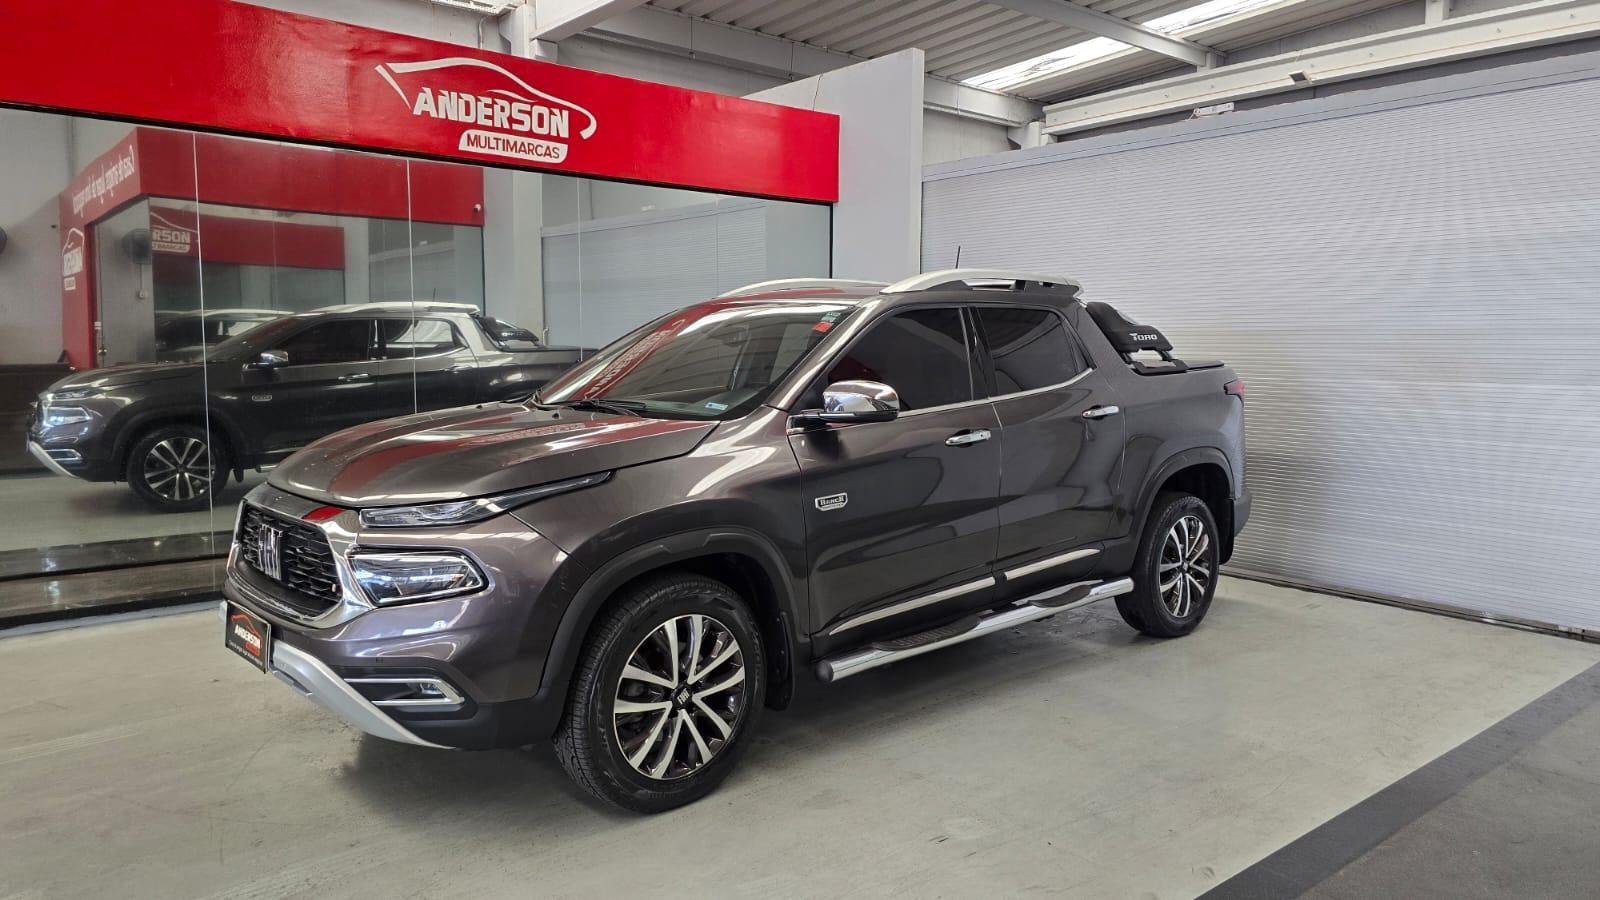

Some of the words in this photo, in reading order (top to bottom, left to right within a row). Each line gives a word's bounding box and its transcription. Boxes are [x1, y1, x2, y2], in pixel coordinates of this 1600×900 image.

[413, 87, 569, 138] ANDERSON
[466, 133, 560, 159] MULTIMARCAS
[152, 229, 190, 243] RSON
[1129, 332, 1158, 341] TORO
